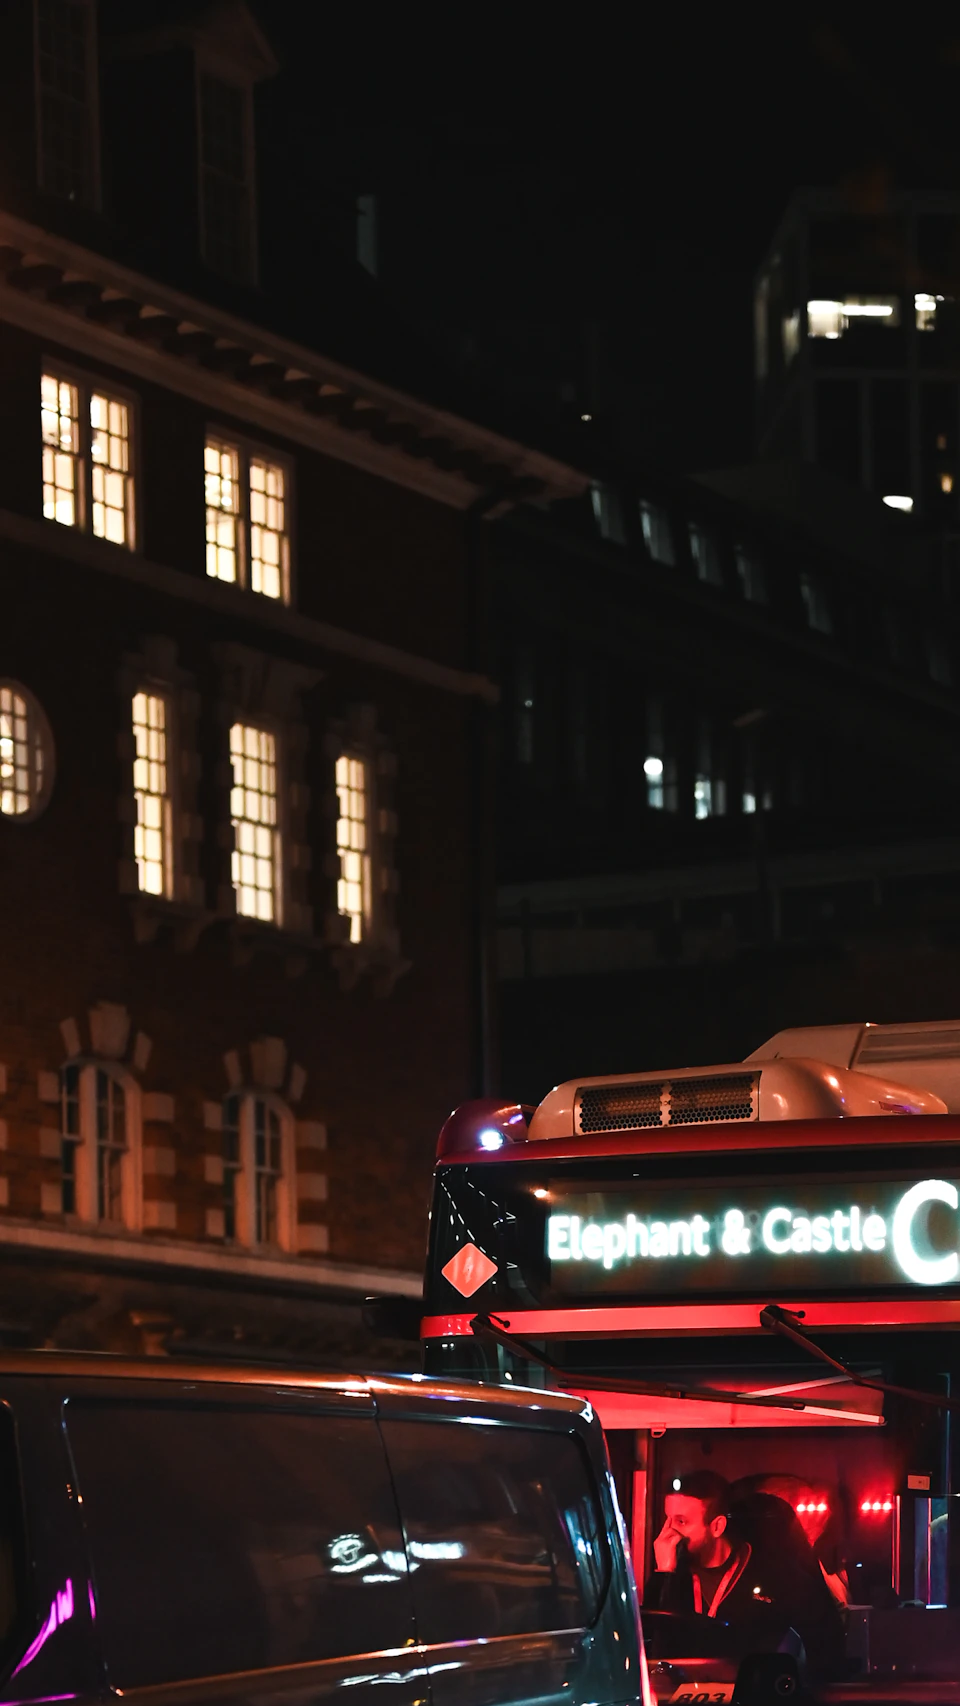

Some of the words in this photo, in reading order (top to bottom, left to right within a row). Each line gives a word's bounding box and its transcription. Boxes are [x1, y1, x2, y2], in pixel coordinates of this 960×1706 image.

[547, 1215, 710, 1269] Elephant
[722, 1209, 751, 1255] &
[762, 1206, 887, 1254] Castle
